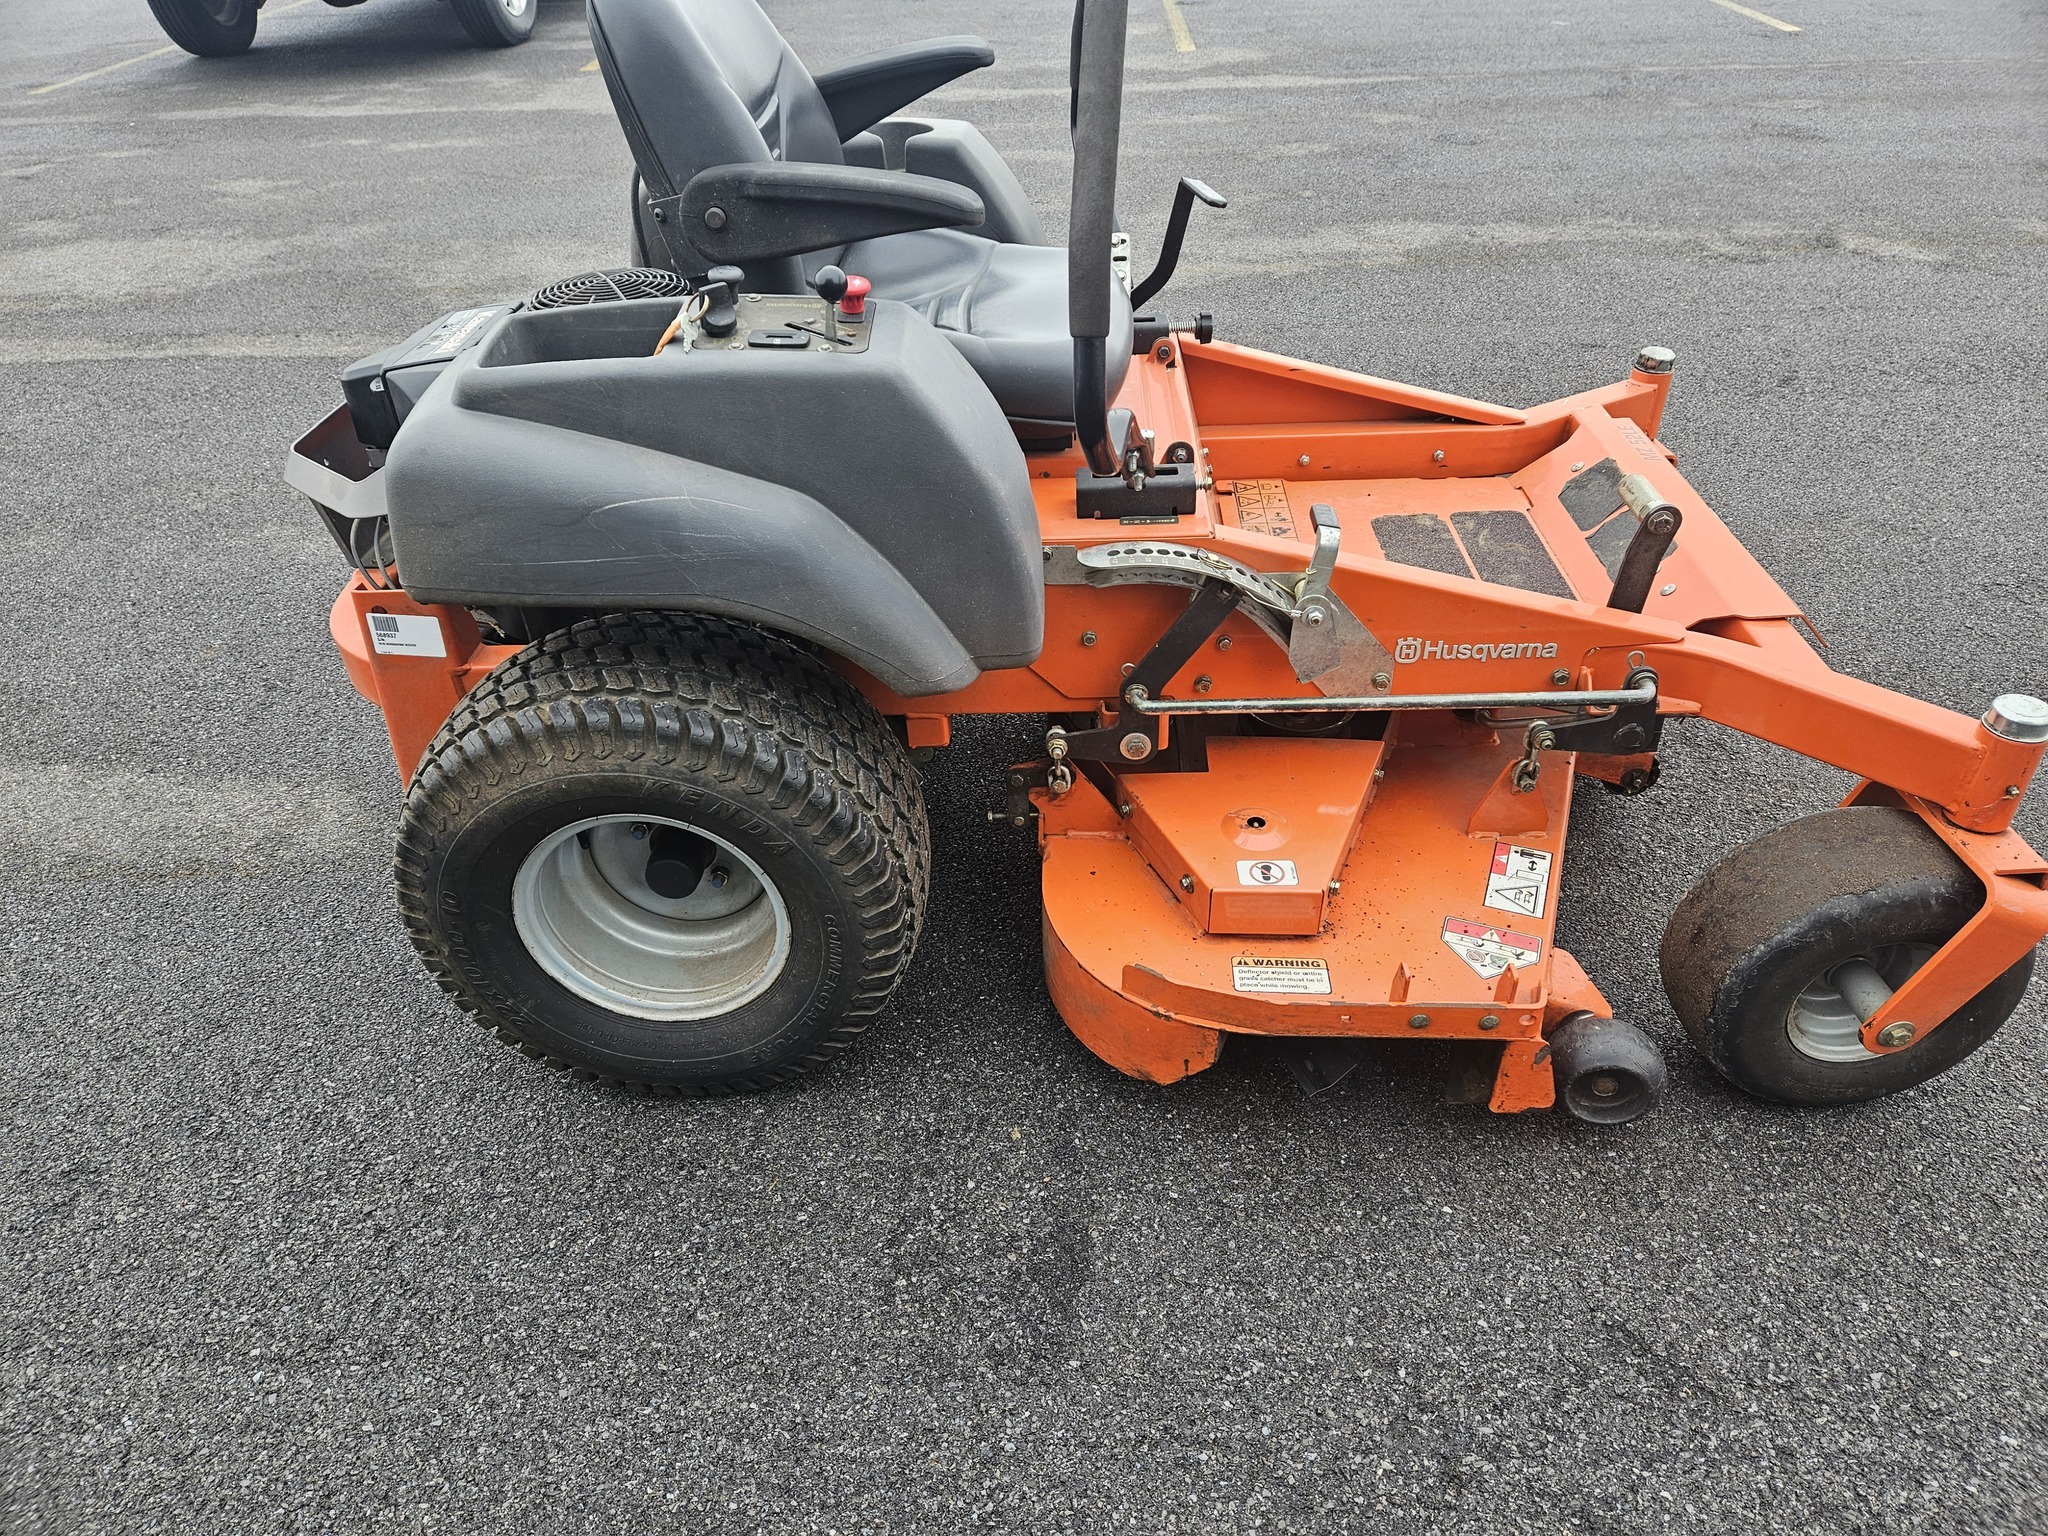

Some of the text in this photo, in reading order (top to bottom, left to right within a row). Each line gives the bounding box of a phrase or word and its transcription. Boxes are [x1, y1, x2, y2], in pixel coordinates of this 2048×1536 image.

[1422, 640, 1558, 663] Husqvarna
[639, 779, 795, 857] KENDA
[1238, 968, 1270, 976] Deflector
[1252, 958, 1321, 968] WARNING
[751, 913, 843, 1063] COMMERCIAL TURF
